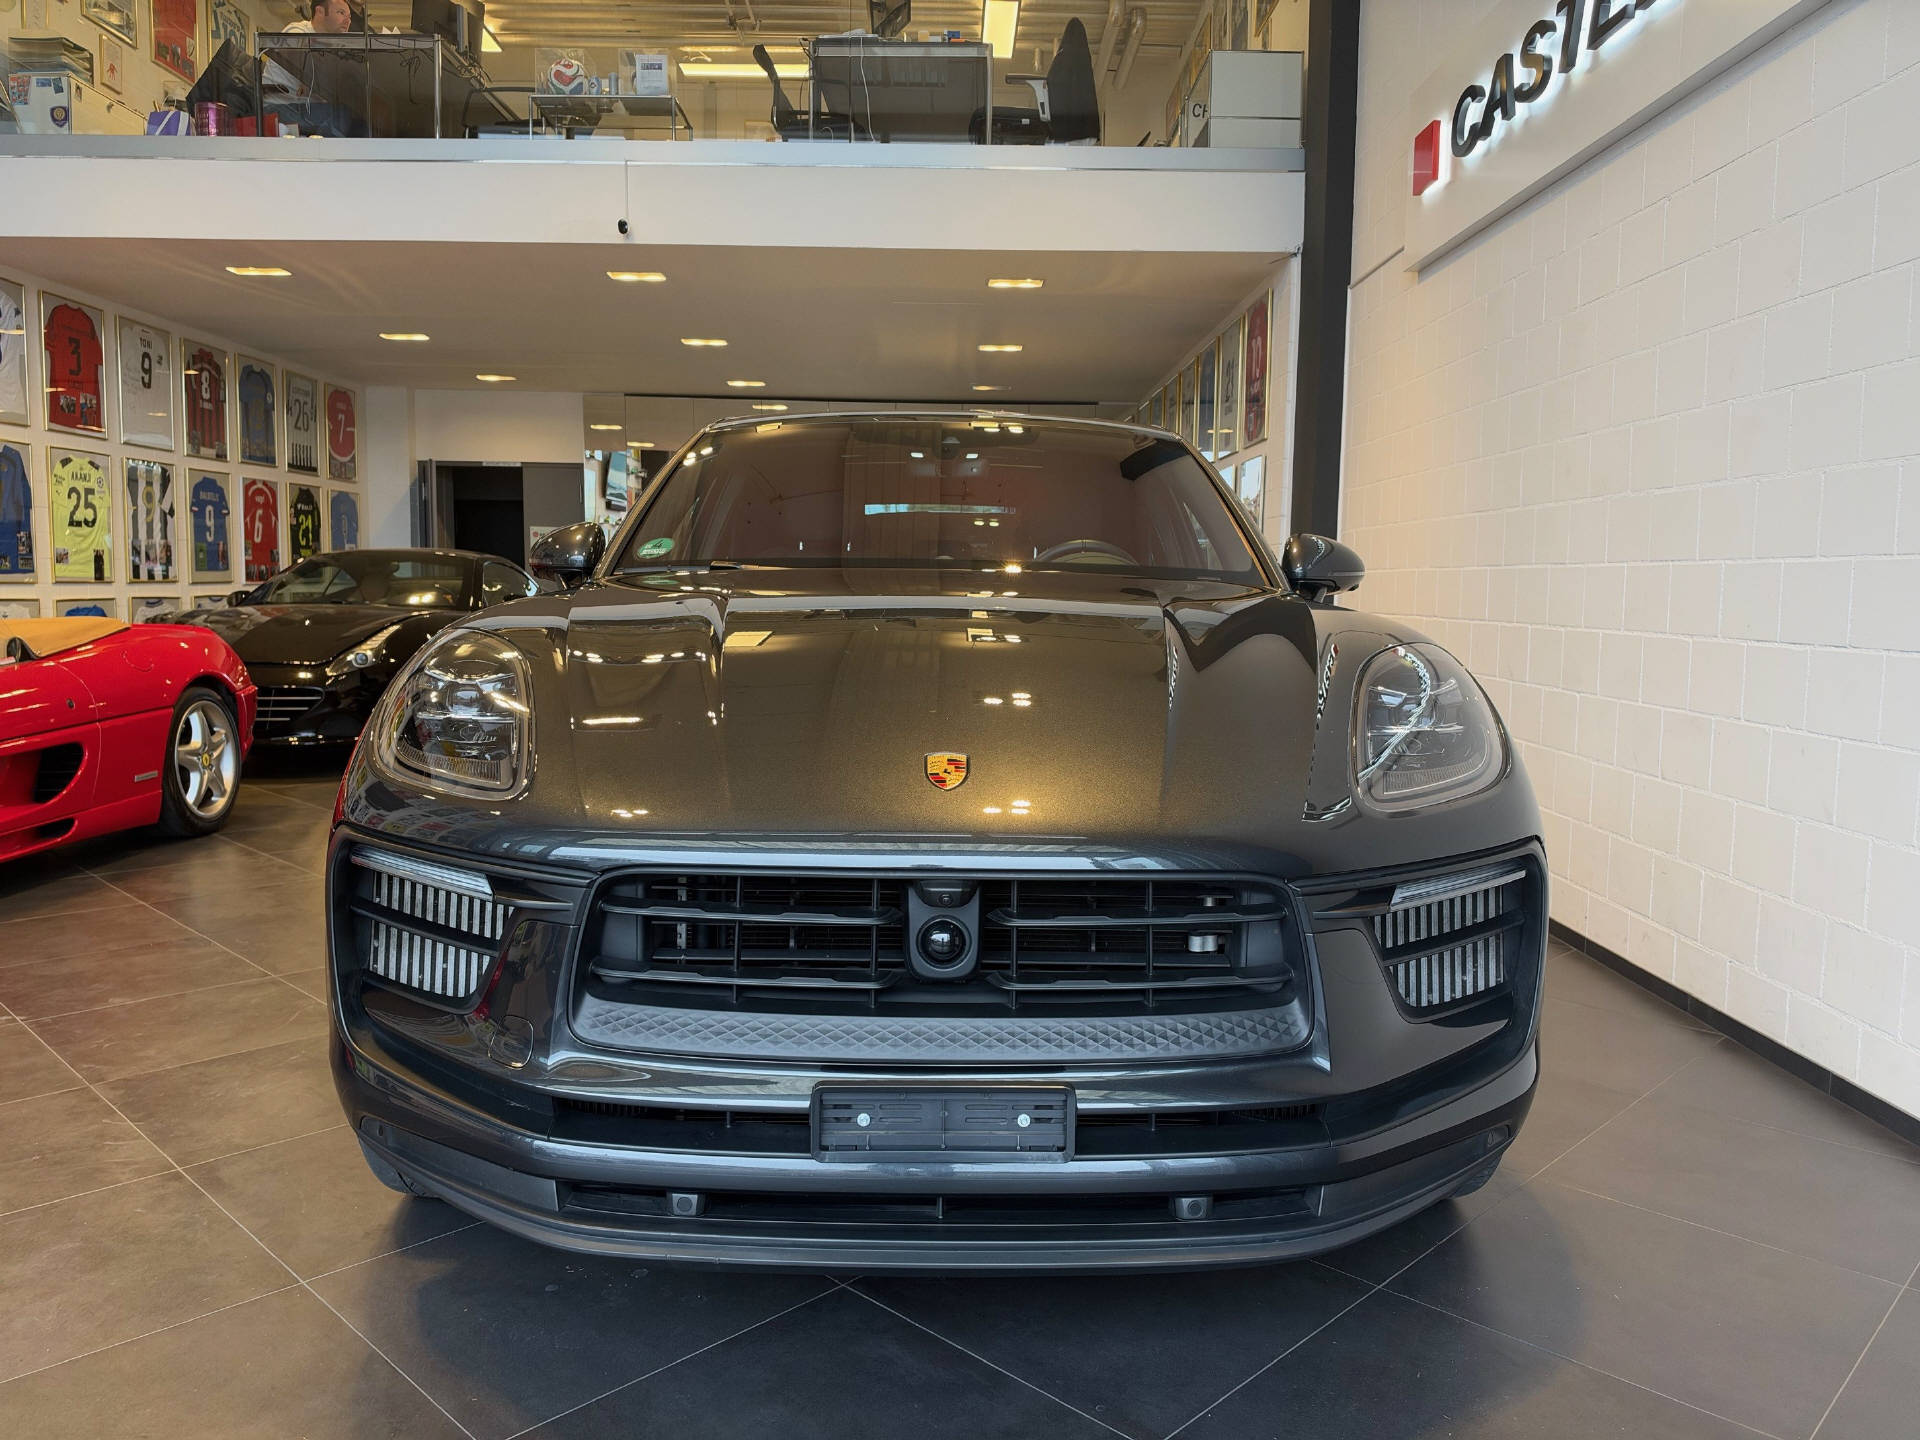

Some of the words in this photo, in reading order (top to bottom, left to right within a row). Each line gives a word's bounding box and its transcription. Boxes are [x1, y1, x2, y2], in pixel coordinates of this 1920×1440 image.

[1451, 0, 1657, 158] CAST
[68, 336, 82, 376] 3
[141, 351, 153, 390] 9
[200, 369, 211, 401] 8
[293, 398, 310, 433] 26
[338, 413, 346, 444] 7
[67, 486, 98, 529] 25
[205, 504, 215, 542] 9
[253, 508, 264, 544] 6
